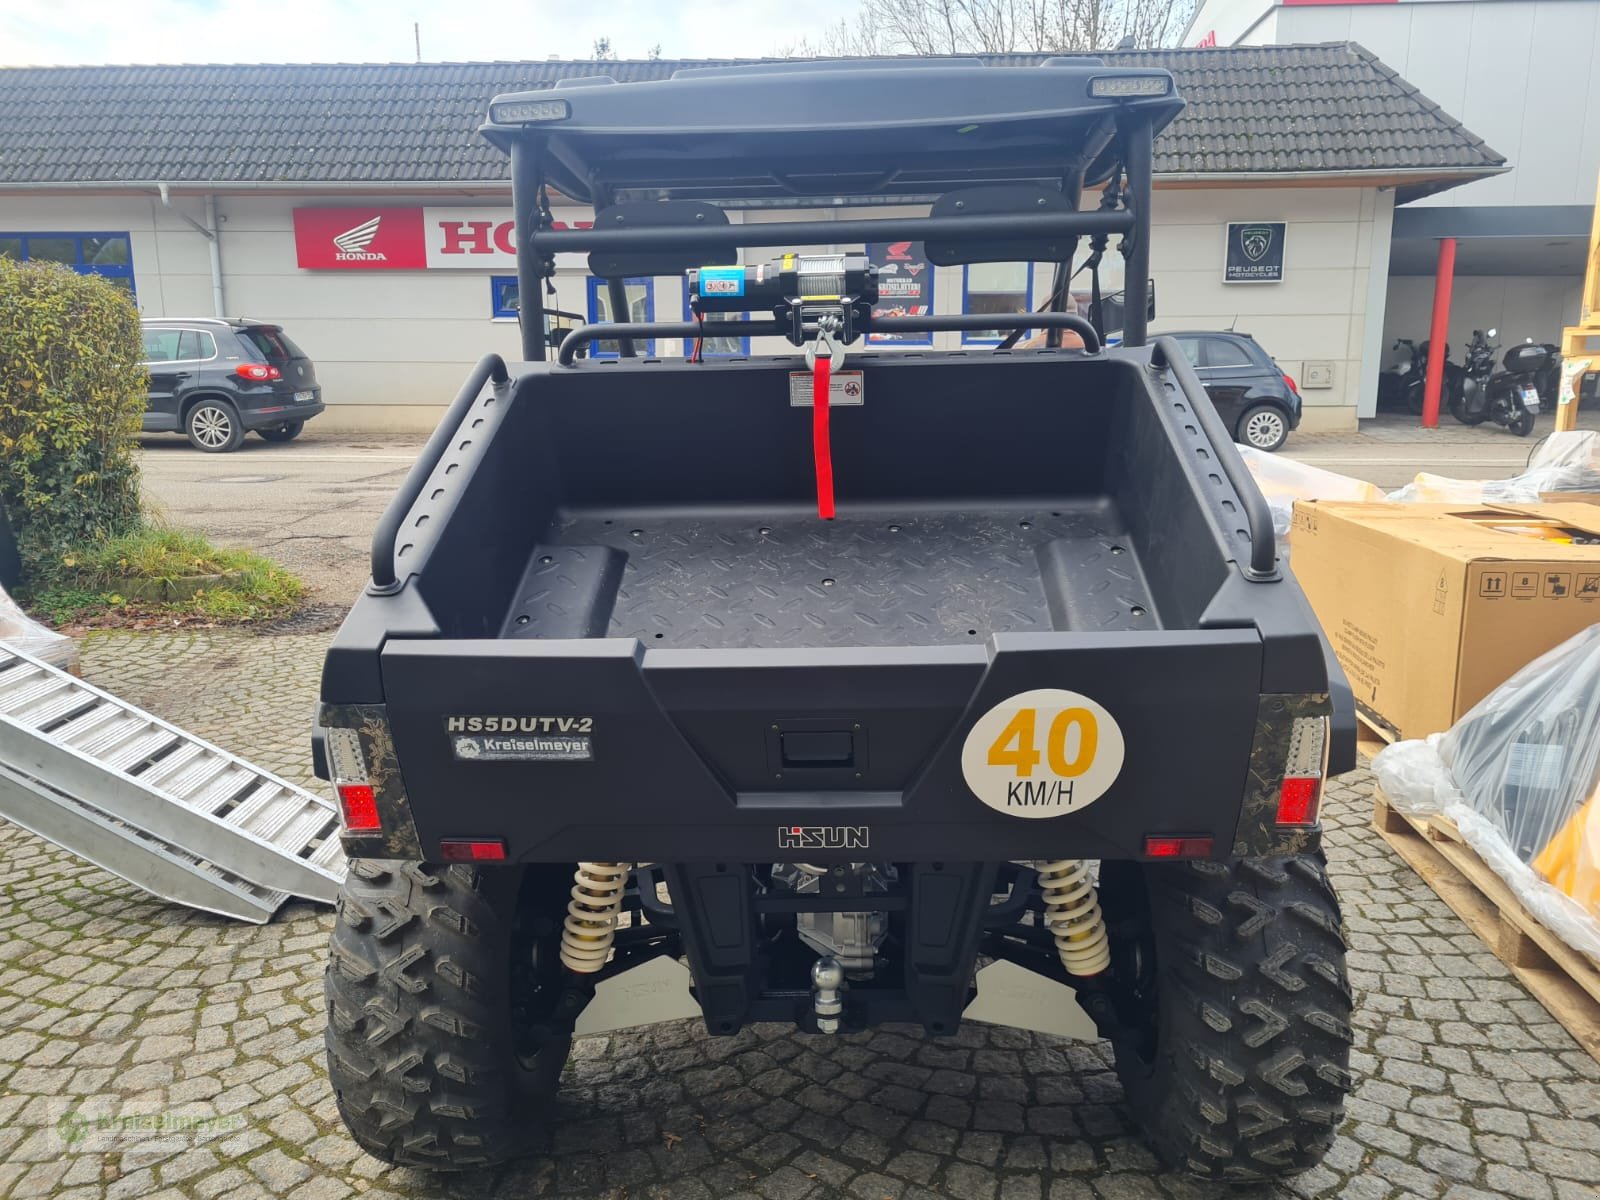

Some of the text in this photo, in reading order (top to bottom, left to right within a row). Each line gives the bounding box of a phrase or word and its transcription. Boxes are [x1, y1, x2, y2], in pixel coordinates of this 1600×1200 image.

[335, 252, 387, 261] HONDA
[448, 716, 593, 732] HS5DUTV-2
[483, 738, 589, 753] Kreiselmeyer
[987, 707, 1099, 778] 40
[1007, 780, 1074, 806] KM/H
[778, 826, 869, 849] HSUN
